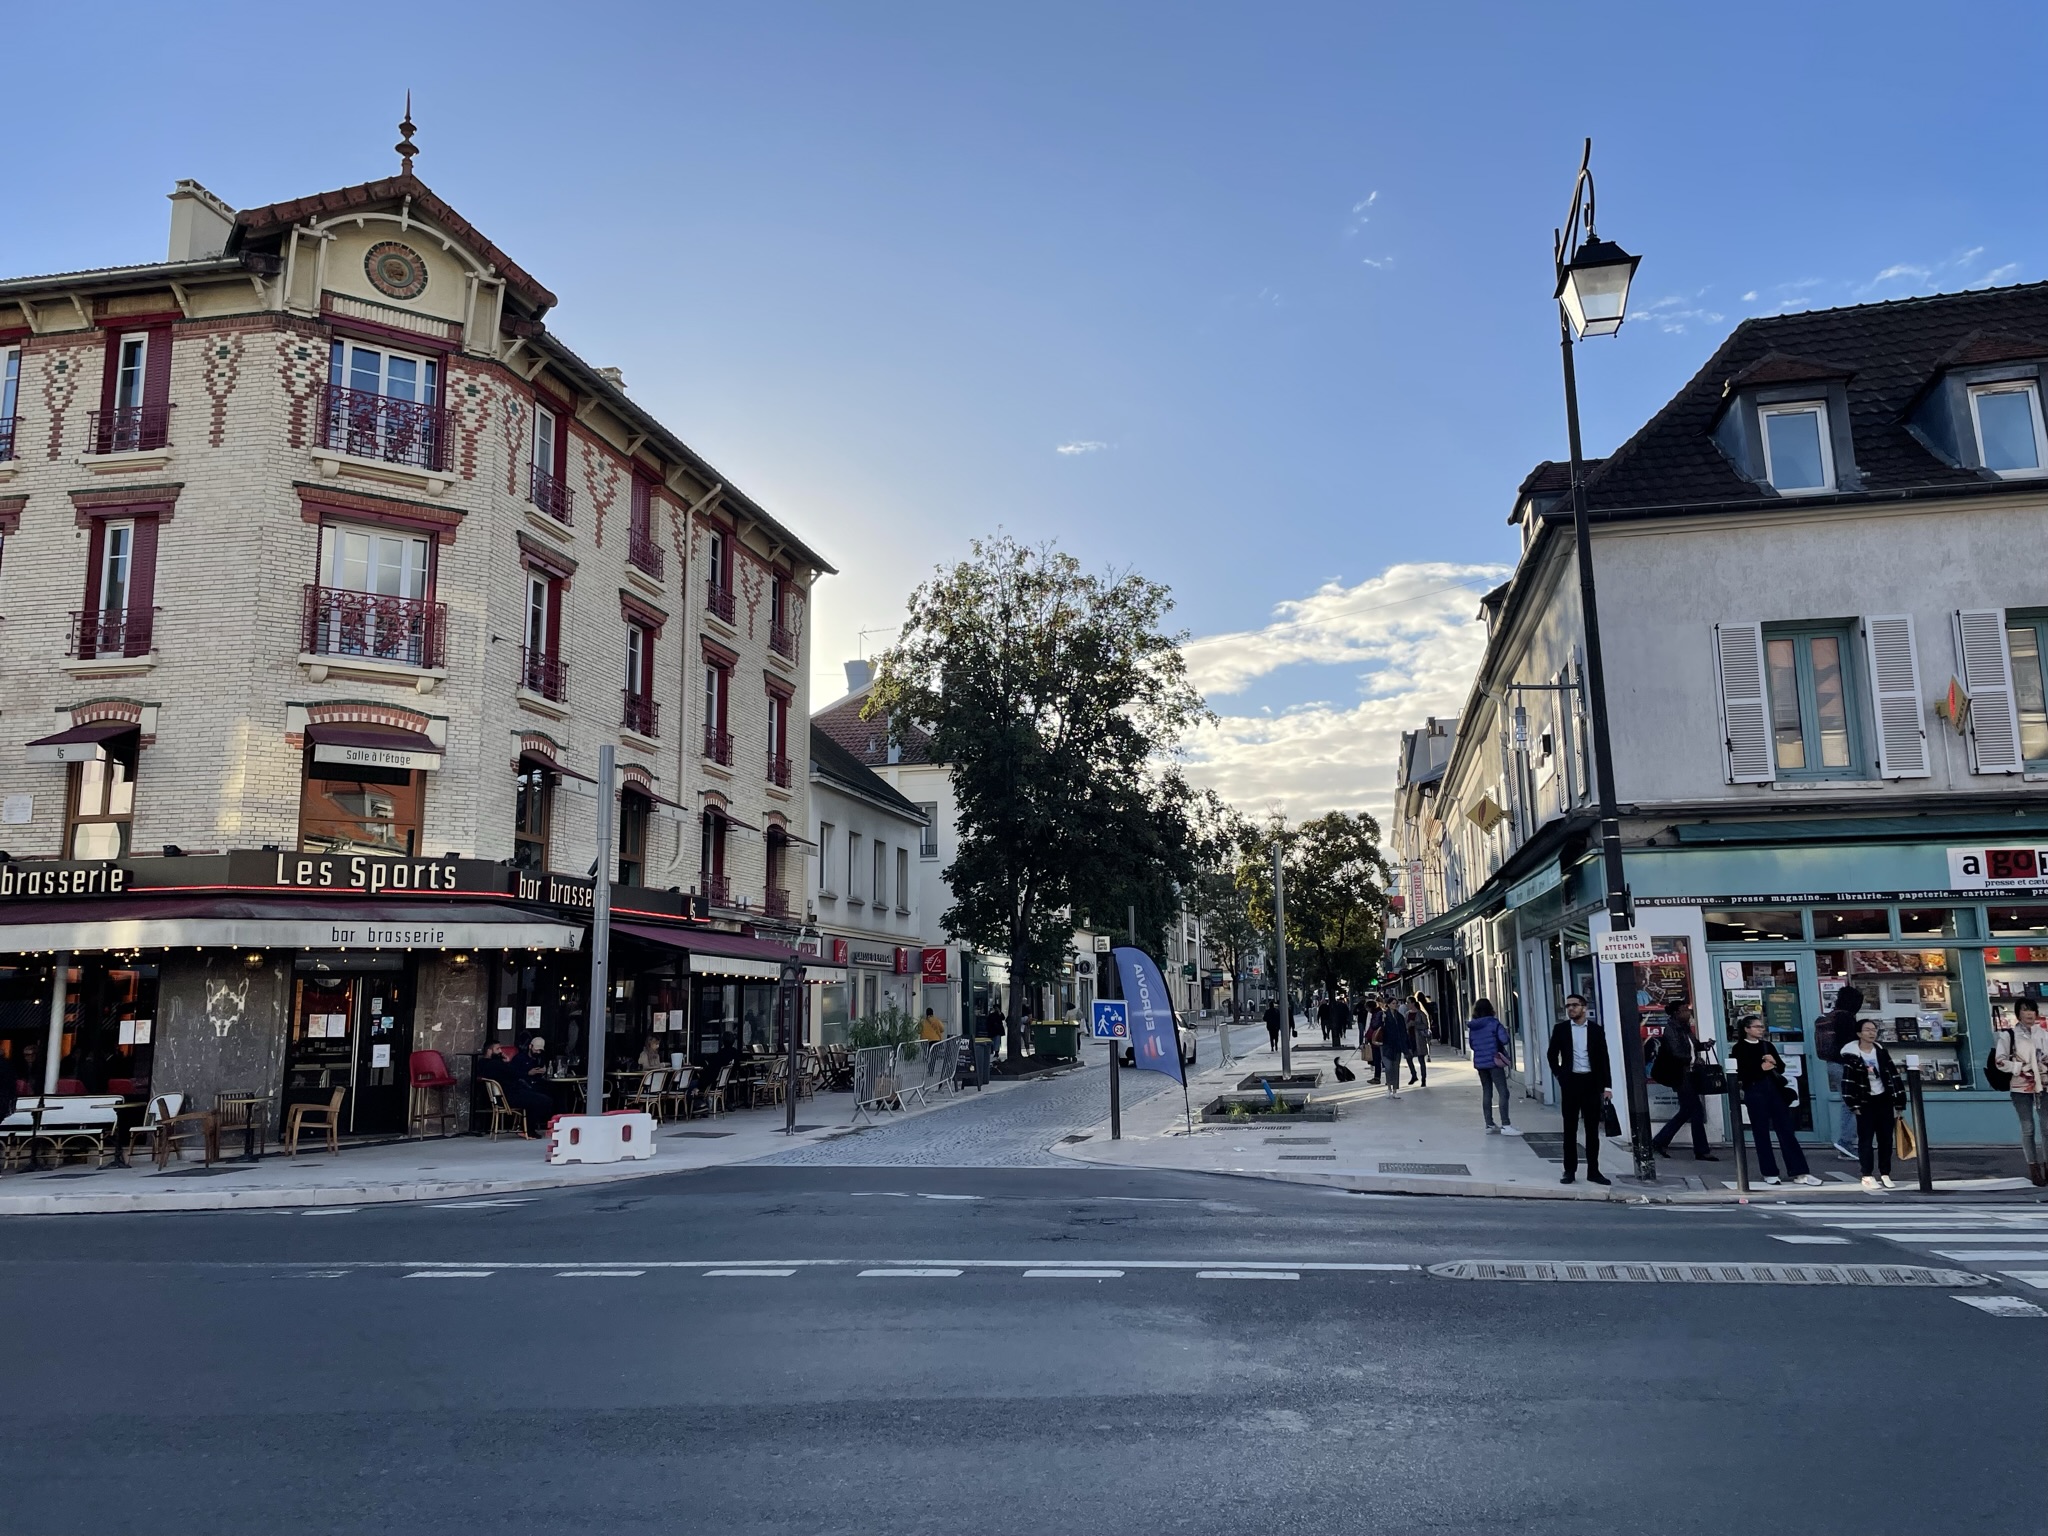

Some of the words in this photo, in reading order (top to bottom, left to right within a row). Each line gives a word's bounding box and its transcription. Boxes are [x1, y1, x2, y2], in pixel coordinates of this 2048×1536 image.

[346, 750, 369, 761] Salle
[372, 752, 377, 761] à
[380, 752, 411, 766] l'étage
[1484, 811, 1505, 832] PRESSE
[1, 862, 124, 896] brasserie
[276, 852, 332, 886] Les
[350, 856, 457, 894] Sports
[518, 870, 542, 899] bar
[549, 876, 596, 908] brasse
[1985, 879, 2015, 887] presse
[2017, 878, 2026, 886] et
[1414, 875, 1425, 926] BOUCHERIE
[1731, 895, 1764, 904] presse
[332, 926, 356, 942] bar
[368, 926, 444, 943] brasserie
[1605, 942, 1645, 951] ATTENTION
[1601, 953, 1618, 961] FEUX
[1651, 953, 1680, 963] Point
[1660, 968, 1686, 979] Vins
[1647, 1026, 1660, 1036] Le
